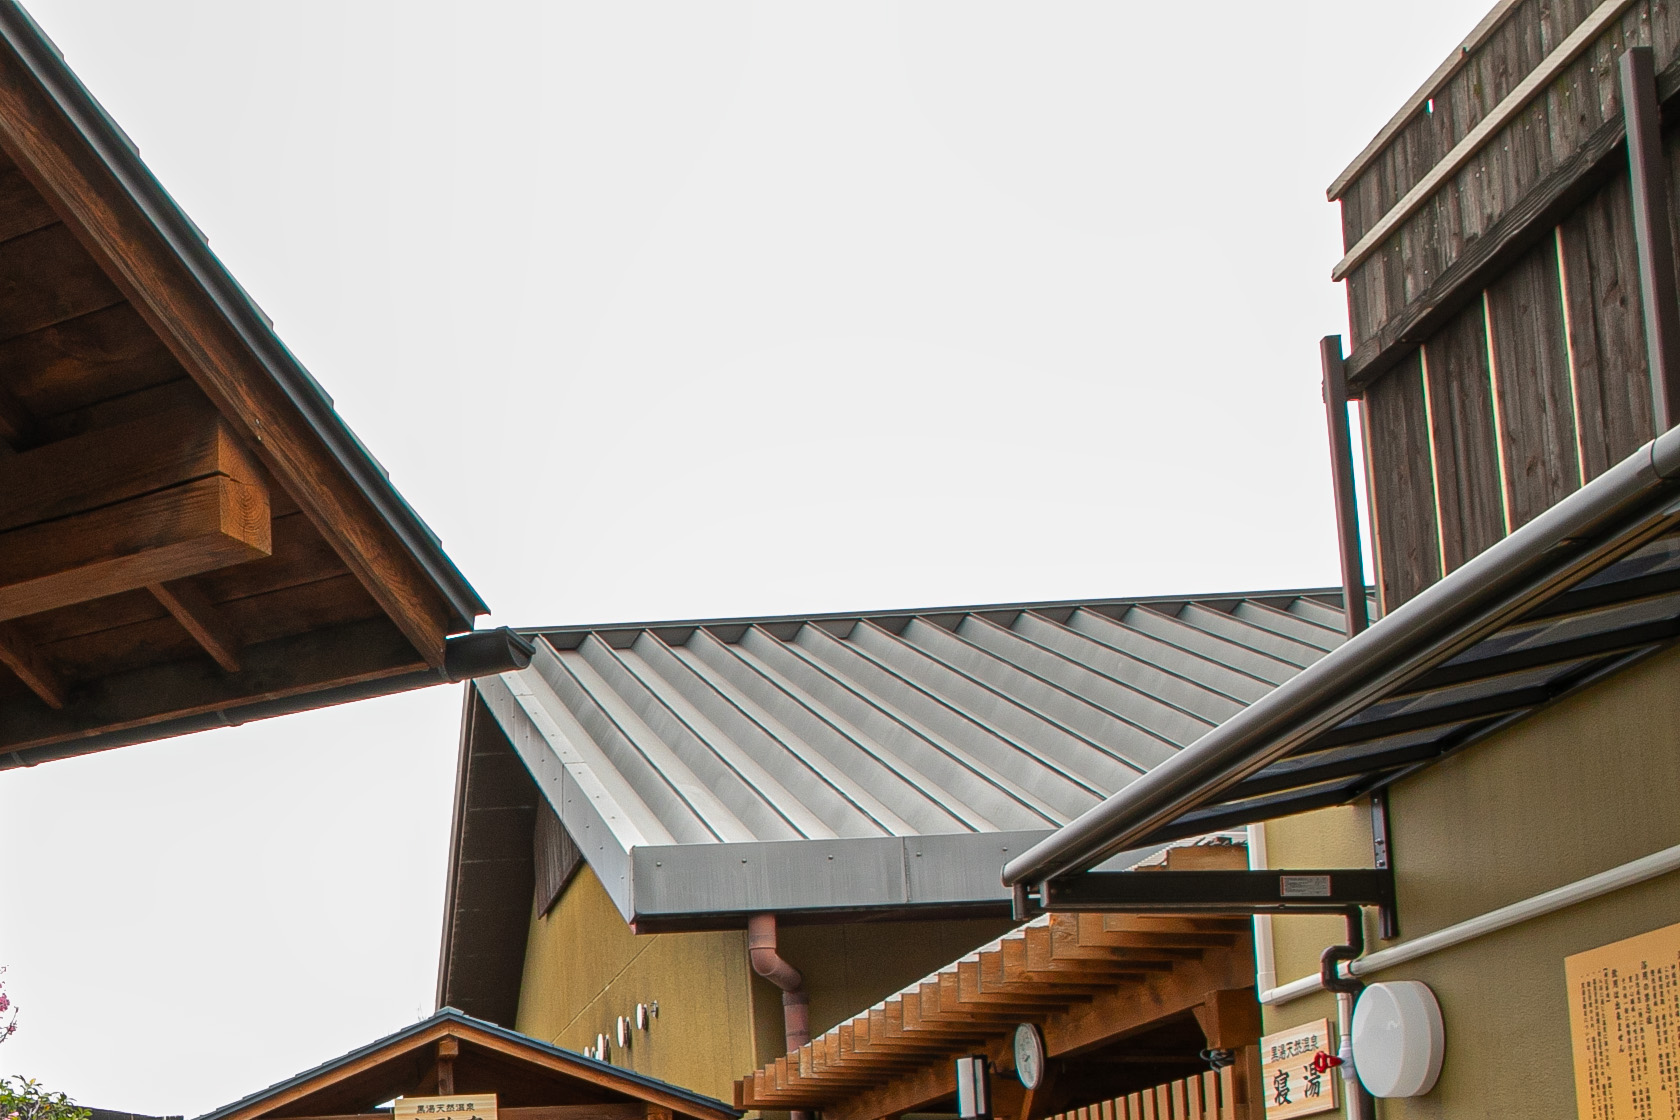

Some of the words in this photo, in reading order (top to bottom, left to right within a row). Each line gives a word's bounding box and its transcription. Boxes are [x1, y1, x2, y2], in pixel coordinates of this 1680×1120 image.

[1271, 1034, 1319, 1063] 黒湯天然温泉
[1273, 1062, 1321, 1106] 寝湯
[417, 1103, 475, 1114] 黒湯天然温泉
